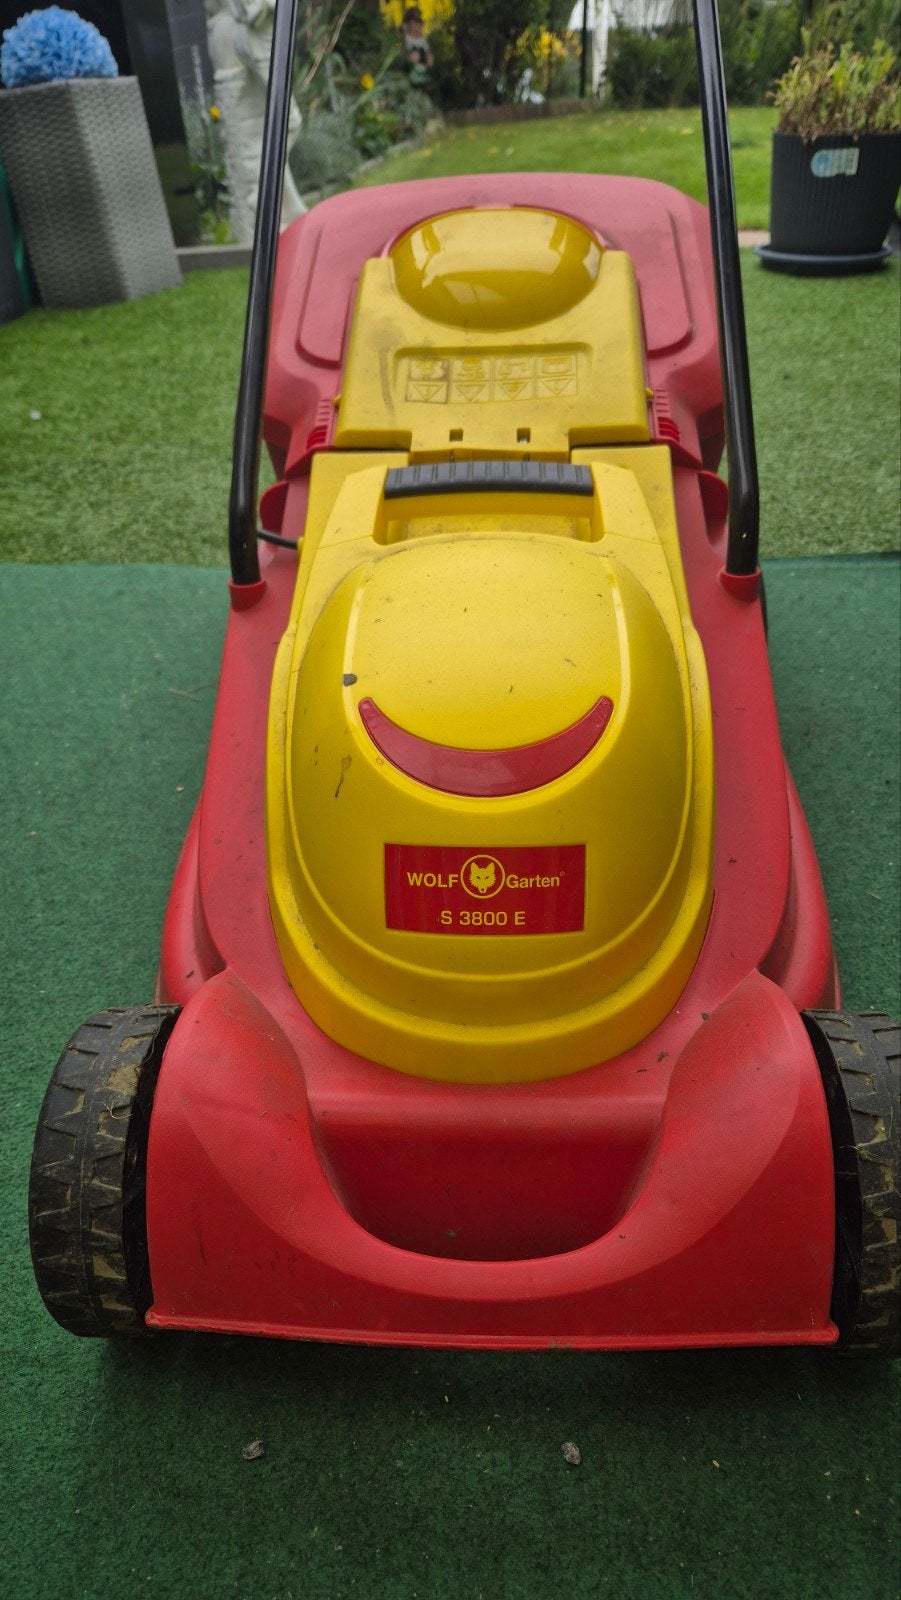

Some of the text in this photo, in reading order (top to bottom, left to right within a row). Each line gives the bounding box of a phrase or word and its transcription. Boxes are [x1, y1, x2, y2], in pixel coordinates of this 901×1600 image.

[406, 871, 459, 888] WOLF
[440, 910, 526, 926] S 3800 E
